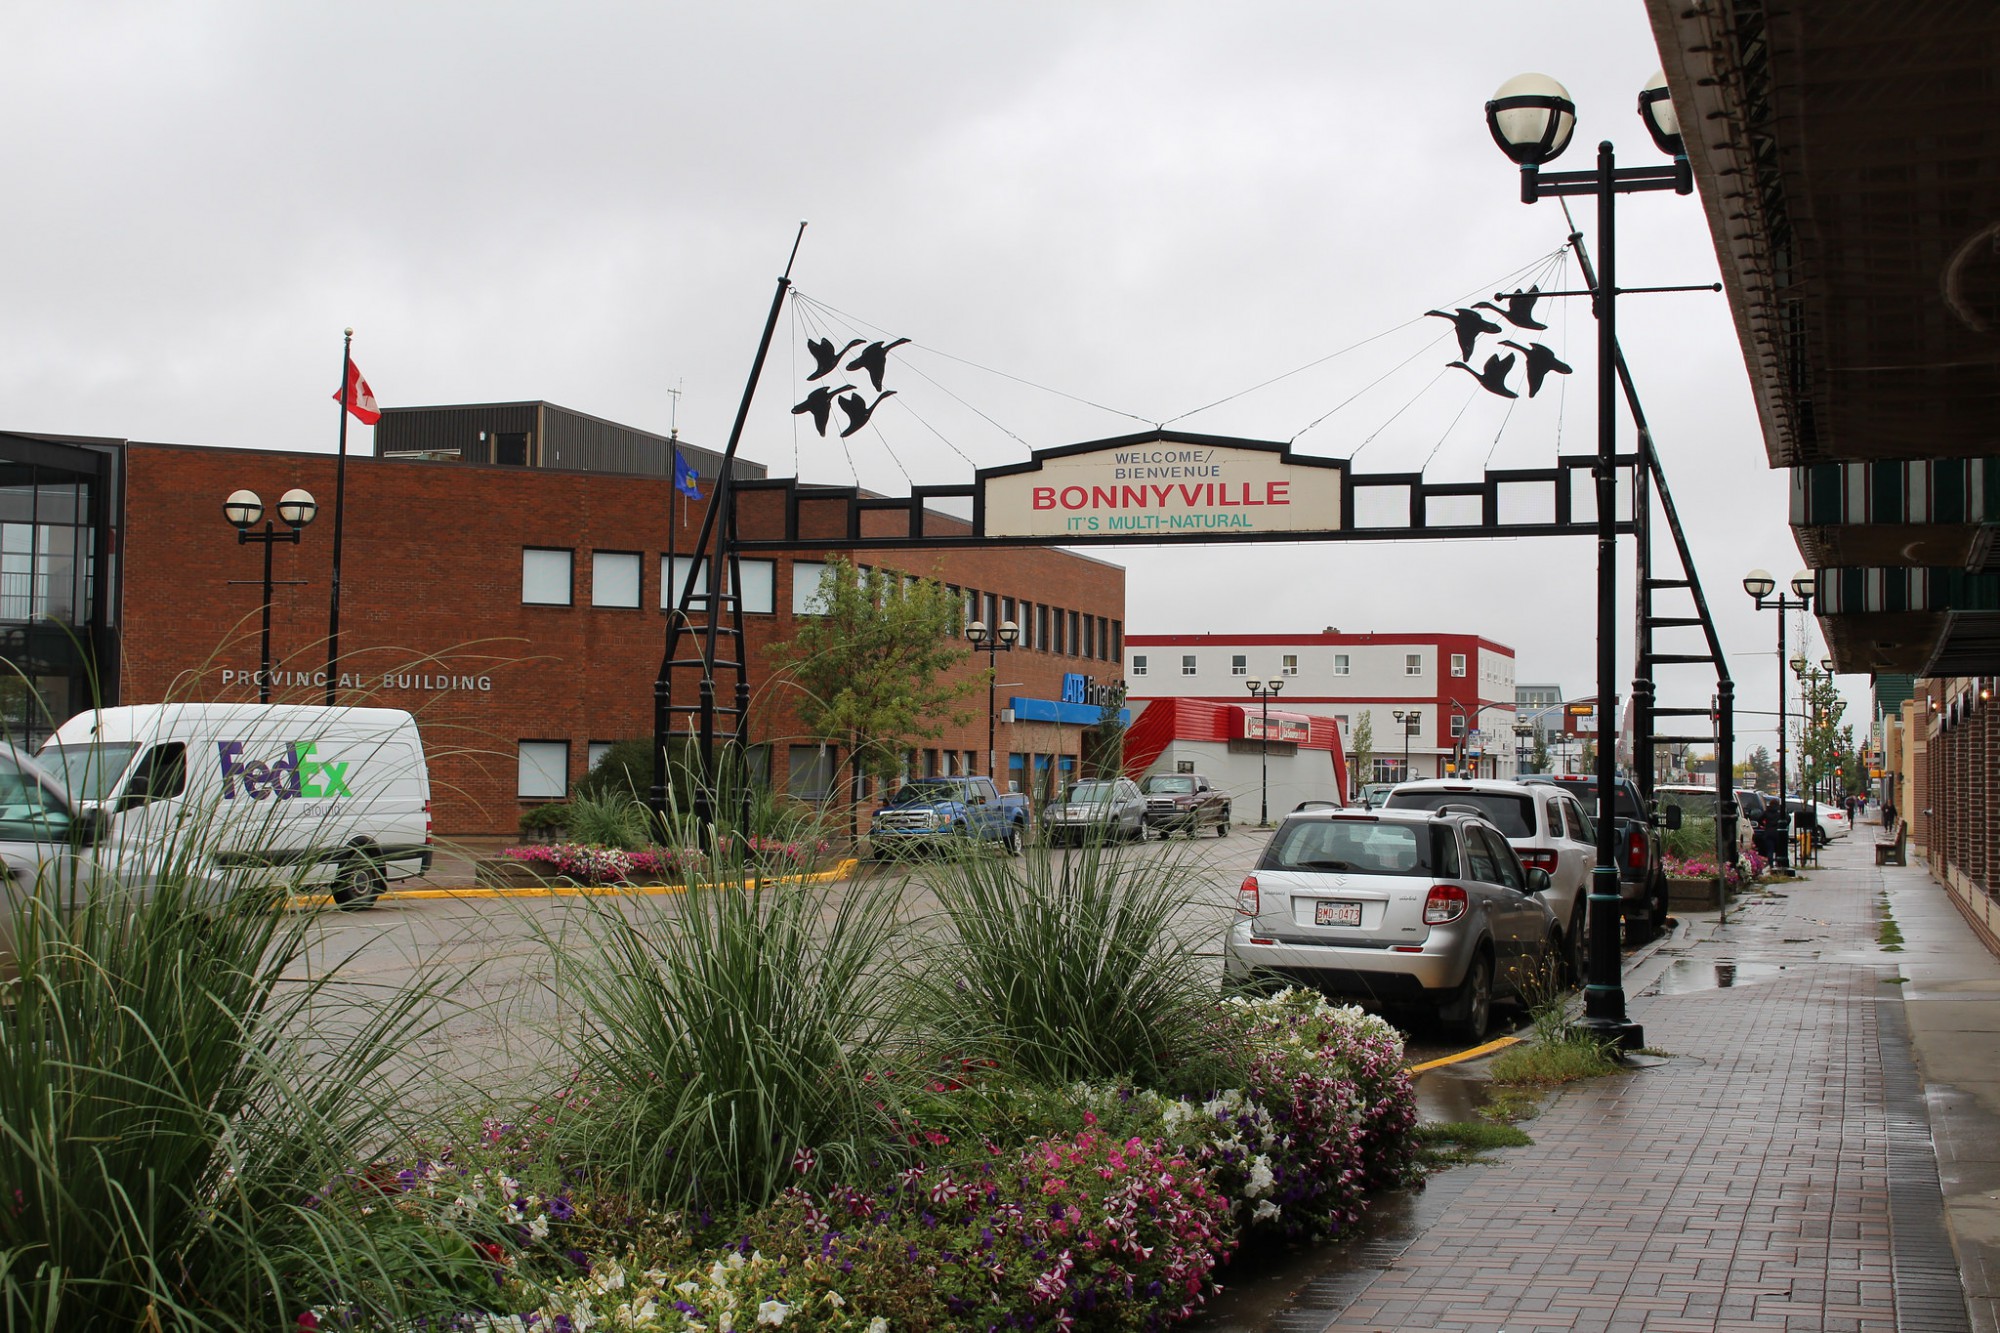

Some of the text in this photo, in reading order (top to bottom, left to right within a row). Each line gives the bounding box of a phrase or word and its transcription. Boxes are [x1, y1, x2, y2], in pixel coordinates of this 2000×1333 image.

[1115, 450, 1215, 464] WELCOME/
[1115, 465, 1220, 480] BIENVENUE
[1032, 481, 1290, 511] BONNYVILLE
[1067, 513, 1253, 531] IT'S MULTI-NATURAL
[222, 669, 492, 691] PROVINCAL BUILDING
[1063, 673, 1085, 704] ATB
[217, 741, 353, 800] FedEx
[302, 803, 341, 817] Ground
